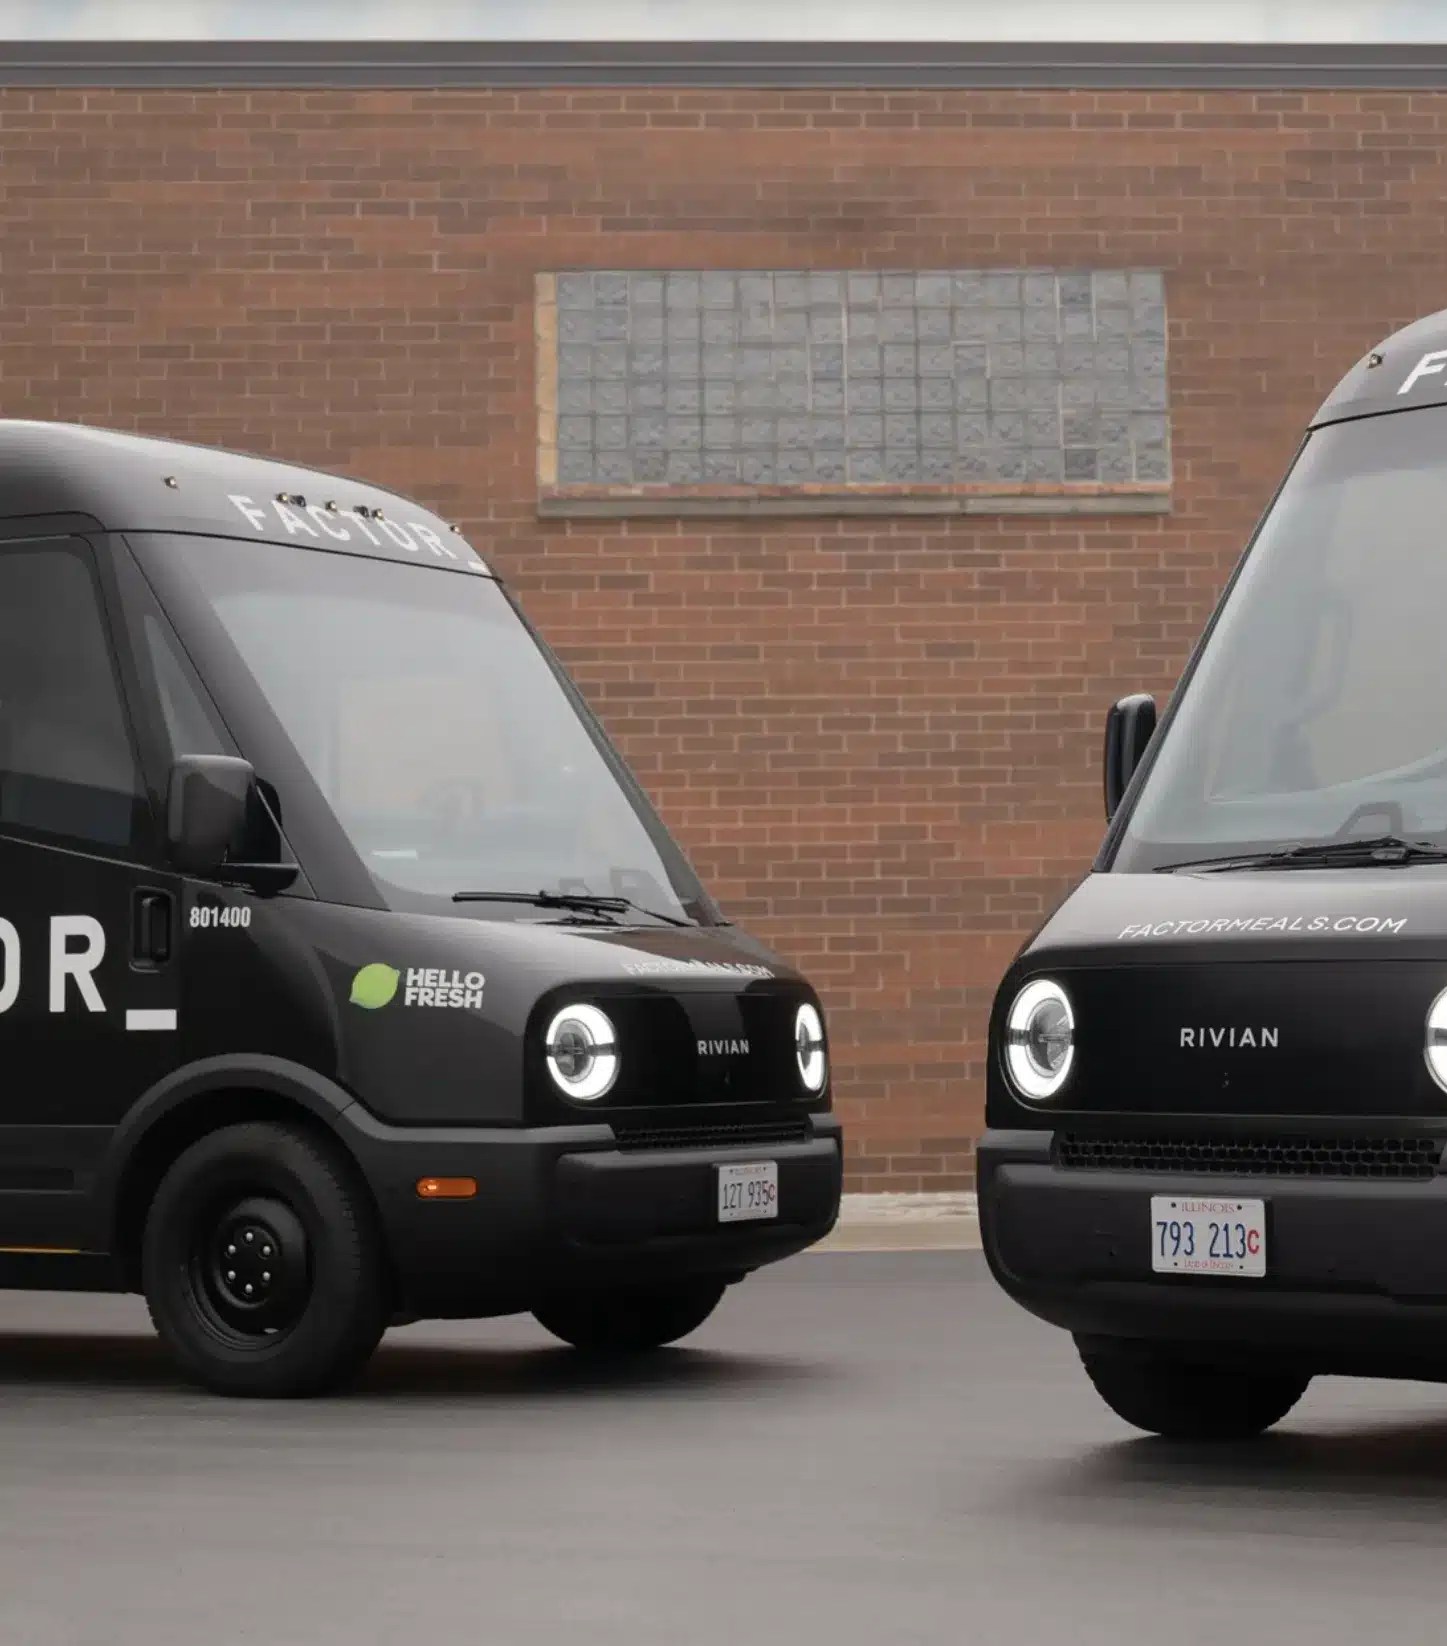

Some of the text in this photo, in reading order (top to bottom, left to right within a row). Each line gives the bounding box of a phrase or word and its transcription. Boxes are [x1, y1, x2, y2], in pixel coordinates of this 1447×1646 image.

[189, 906, 251, 928] 801400
[1117, 916, 1409, 939] FACTORMEALS.COM
[406, 967, 485, 990] HELLO
[404, 987, 483, 1009] FRESH
[697, 1039, 750, 1055] RIVIAN
[1180, 1027, 1279, 1048] RIVIAN
[723, 1182, 743, 1210] 127
[1156, 1220, 1195, 1257] 793
